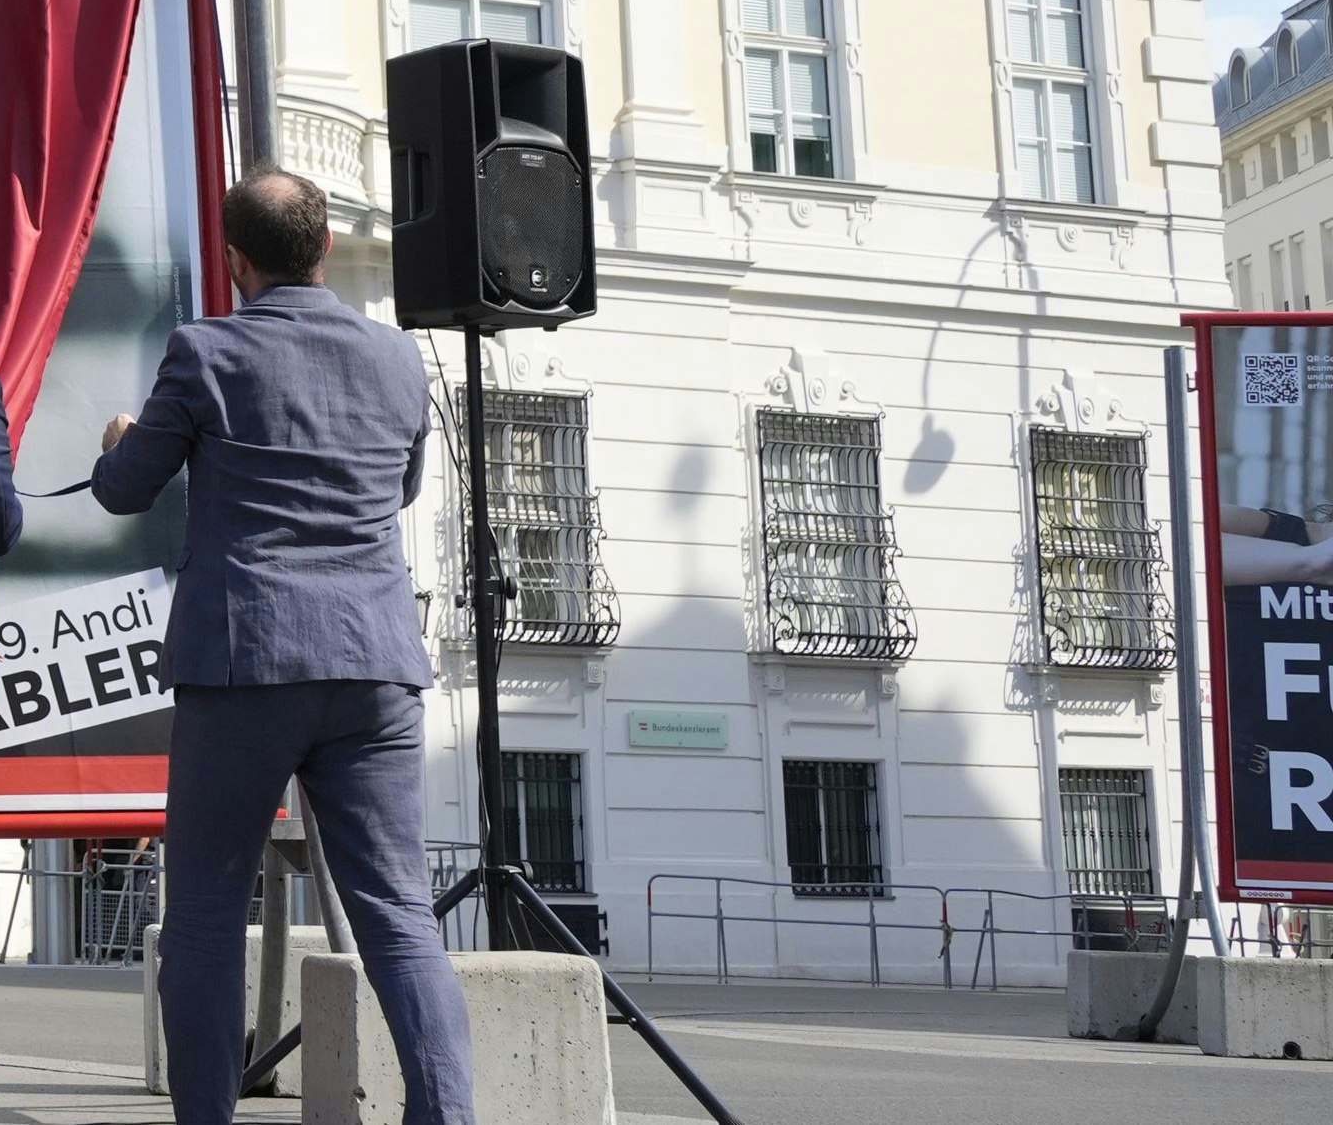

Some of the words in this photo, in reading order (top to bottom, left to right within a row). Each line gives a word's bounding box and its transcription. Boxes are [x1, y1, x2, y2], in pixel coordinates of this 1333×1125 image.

[52, 588, 154, 649] Andi
[1264, 642, 1333, 721] F
[652, 723, 721, 734] Bundeskanzleramt
[1268, 750, 1333, 832] R
